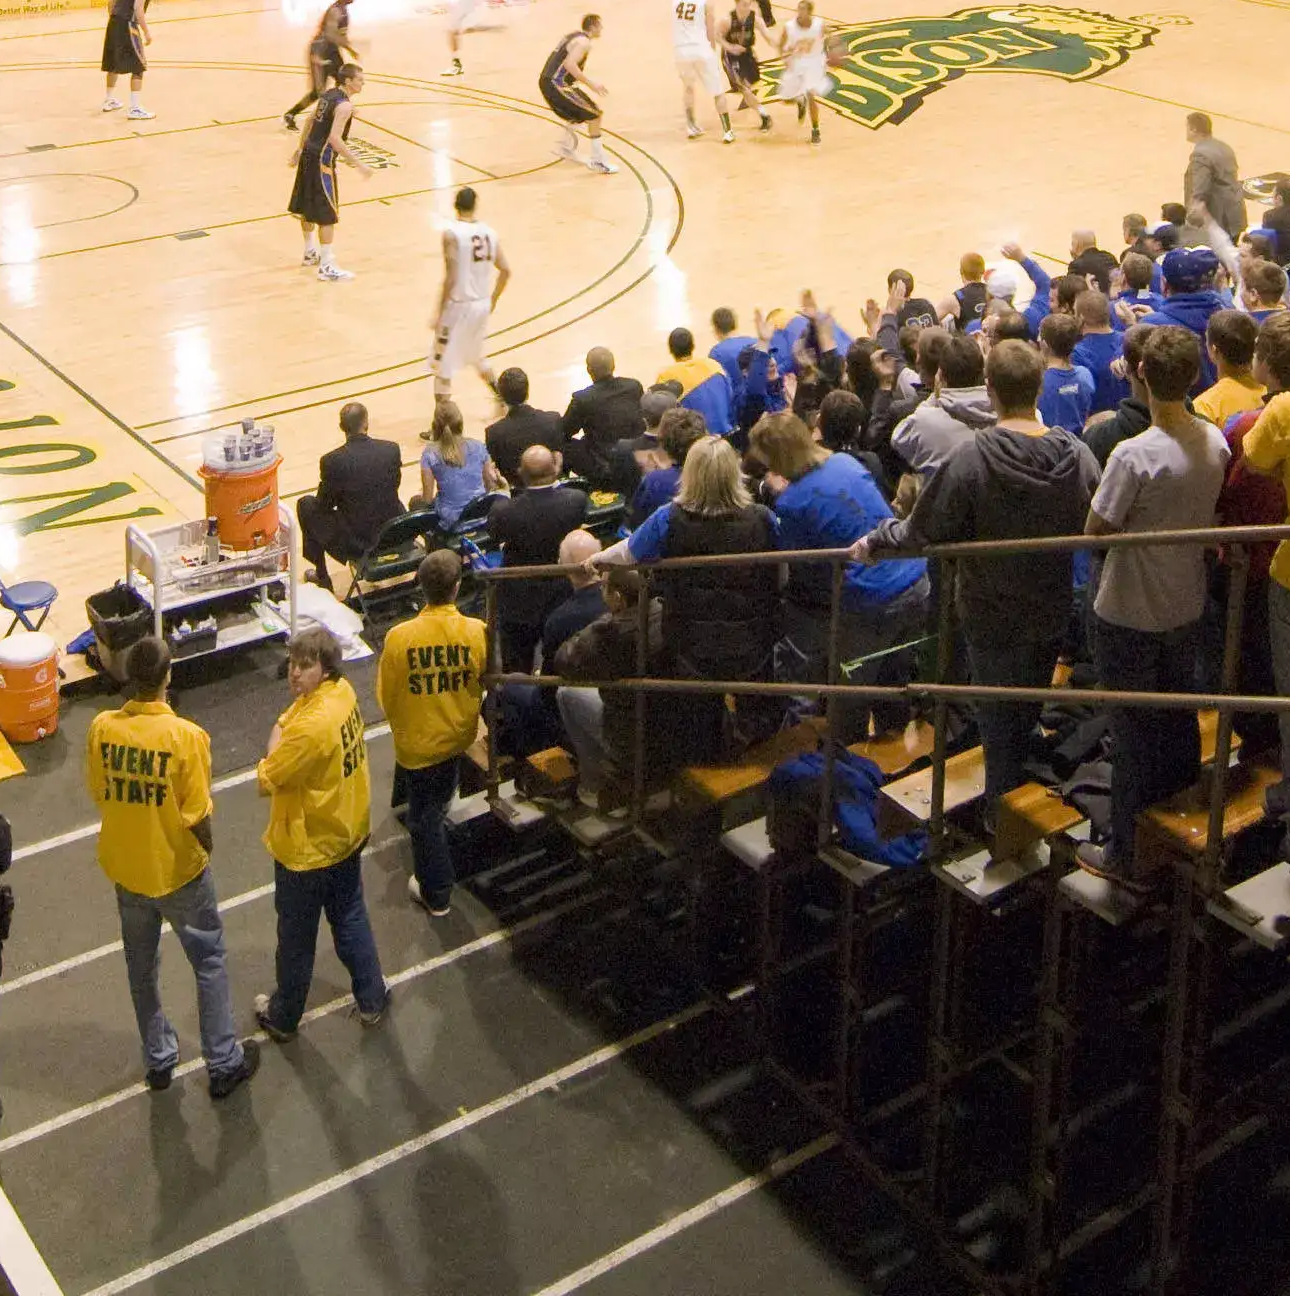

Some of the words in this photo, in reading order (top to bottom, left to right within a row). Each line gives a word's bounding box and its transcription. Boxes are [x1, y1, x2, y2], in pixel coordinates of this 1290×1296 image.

[675, 2, 697, 21] 42
[821, 27, 1057, 126] BISON
[470, 234, 494, 263] 21
[407, 644, 471, 670] EVENT
[408, 670, 470, 695] STAFF
